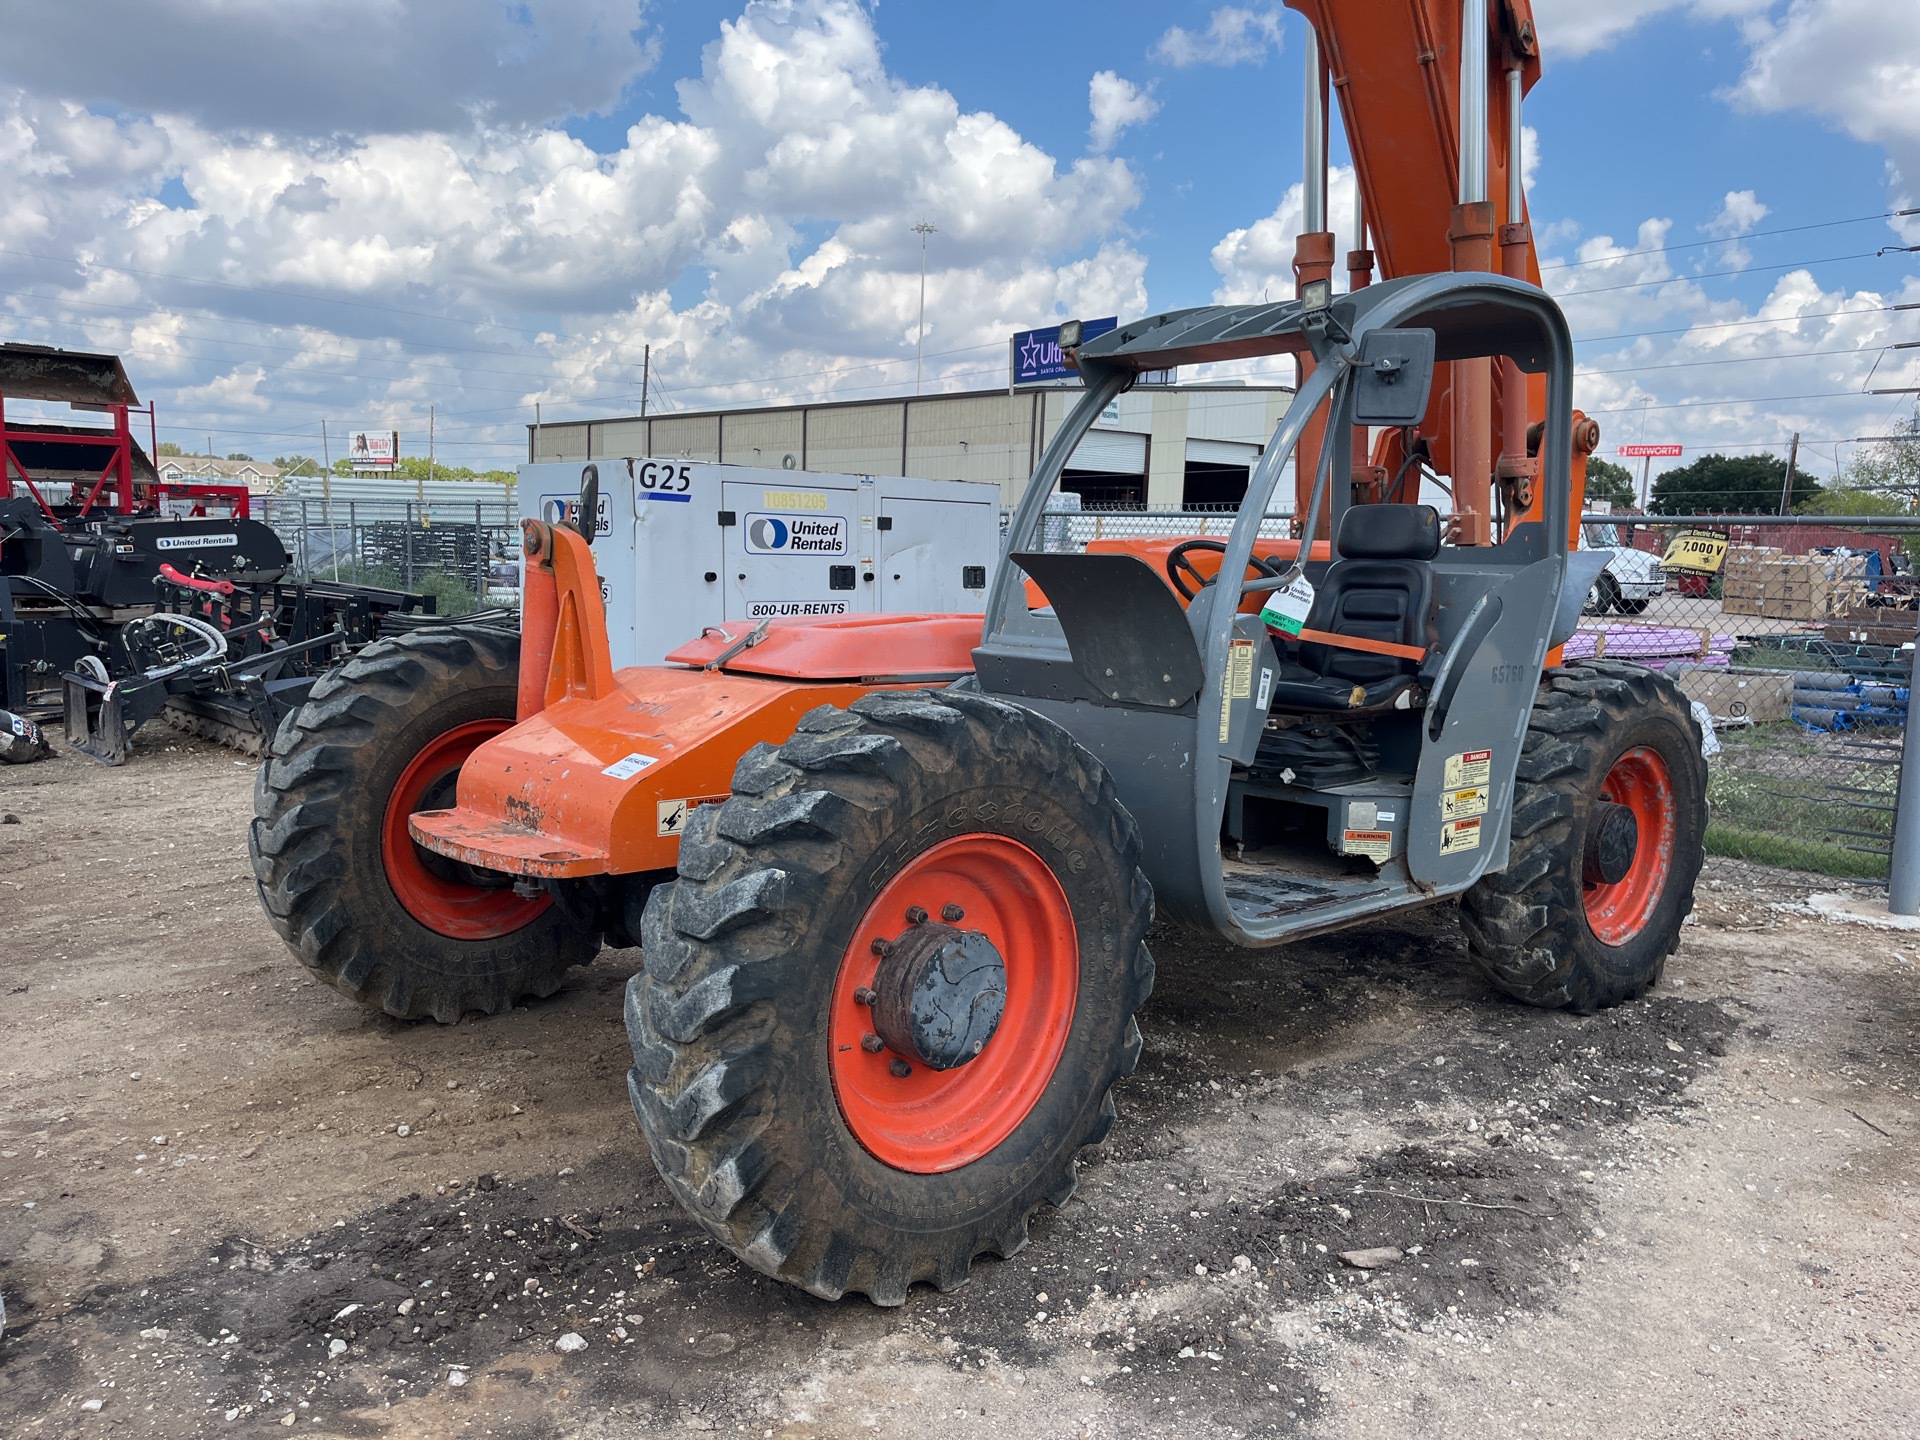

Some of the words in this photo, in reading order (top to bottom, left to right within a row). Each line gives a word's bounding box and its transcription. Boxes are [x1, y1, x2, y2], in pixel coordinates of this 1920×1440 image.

[1627, 446, 1679, 455] KENWORTH
[639, 462, 690, 492] G25
[765, 492, 826, 509] 10851205
[791, 521, 838, 536] United
[1711, 532, 1726, 540] Fence
[172, 538, 200, 547] United
[203, 537, 233, 545] Rentals
[790, 536, 842, 551] Rentals
[1683, 541, 1714, 554] 7,000
[1716, 545, 1724, 556] V
[1288, 592, 1311, 604] Rentals
[1290, 587, 1311, 598] United
[752, 603, 845, 616] 800-UR-RENTS
[1267, 612, 1286, 622] READY
[1271, 620, 1286, 628] RENT
[1491, 664, 1524, 683] 65760
[1470, 752, 1488, 760] DANGER
[1460, 791, 1476, 799] CAUTION
[1460, 820, 1479, 828] WARNING
